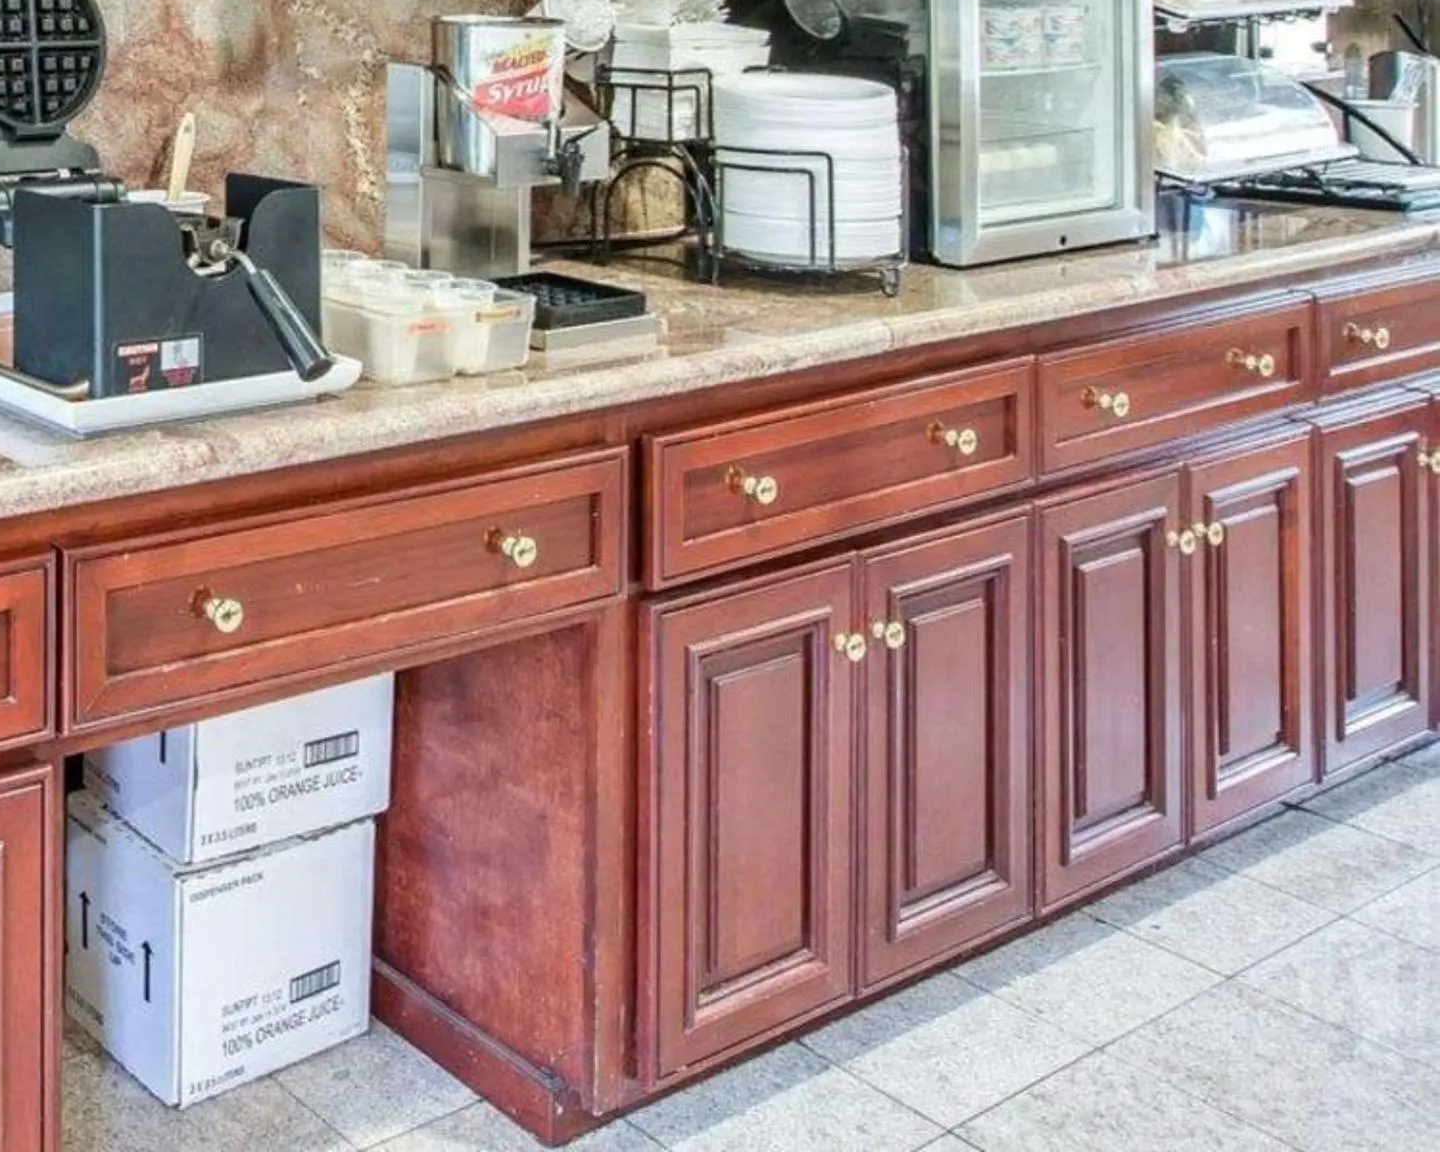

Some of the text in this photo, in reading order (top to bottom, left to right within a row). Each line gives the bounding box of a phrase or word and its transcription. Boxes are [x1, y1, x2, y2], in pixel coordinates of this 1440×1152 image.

[234, 791, 266, 812] 100%
[268, 774, 320, 804] ORANGE
[322, 765, 359, 789] JUICE
[222, 1031, 253, 1058] 100%
[255, 1010, 306, 1044] ORANGE
[308, 995, 340, 1023] JUICE
